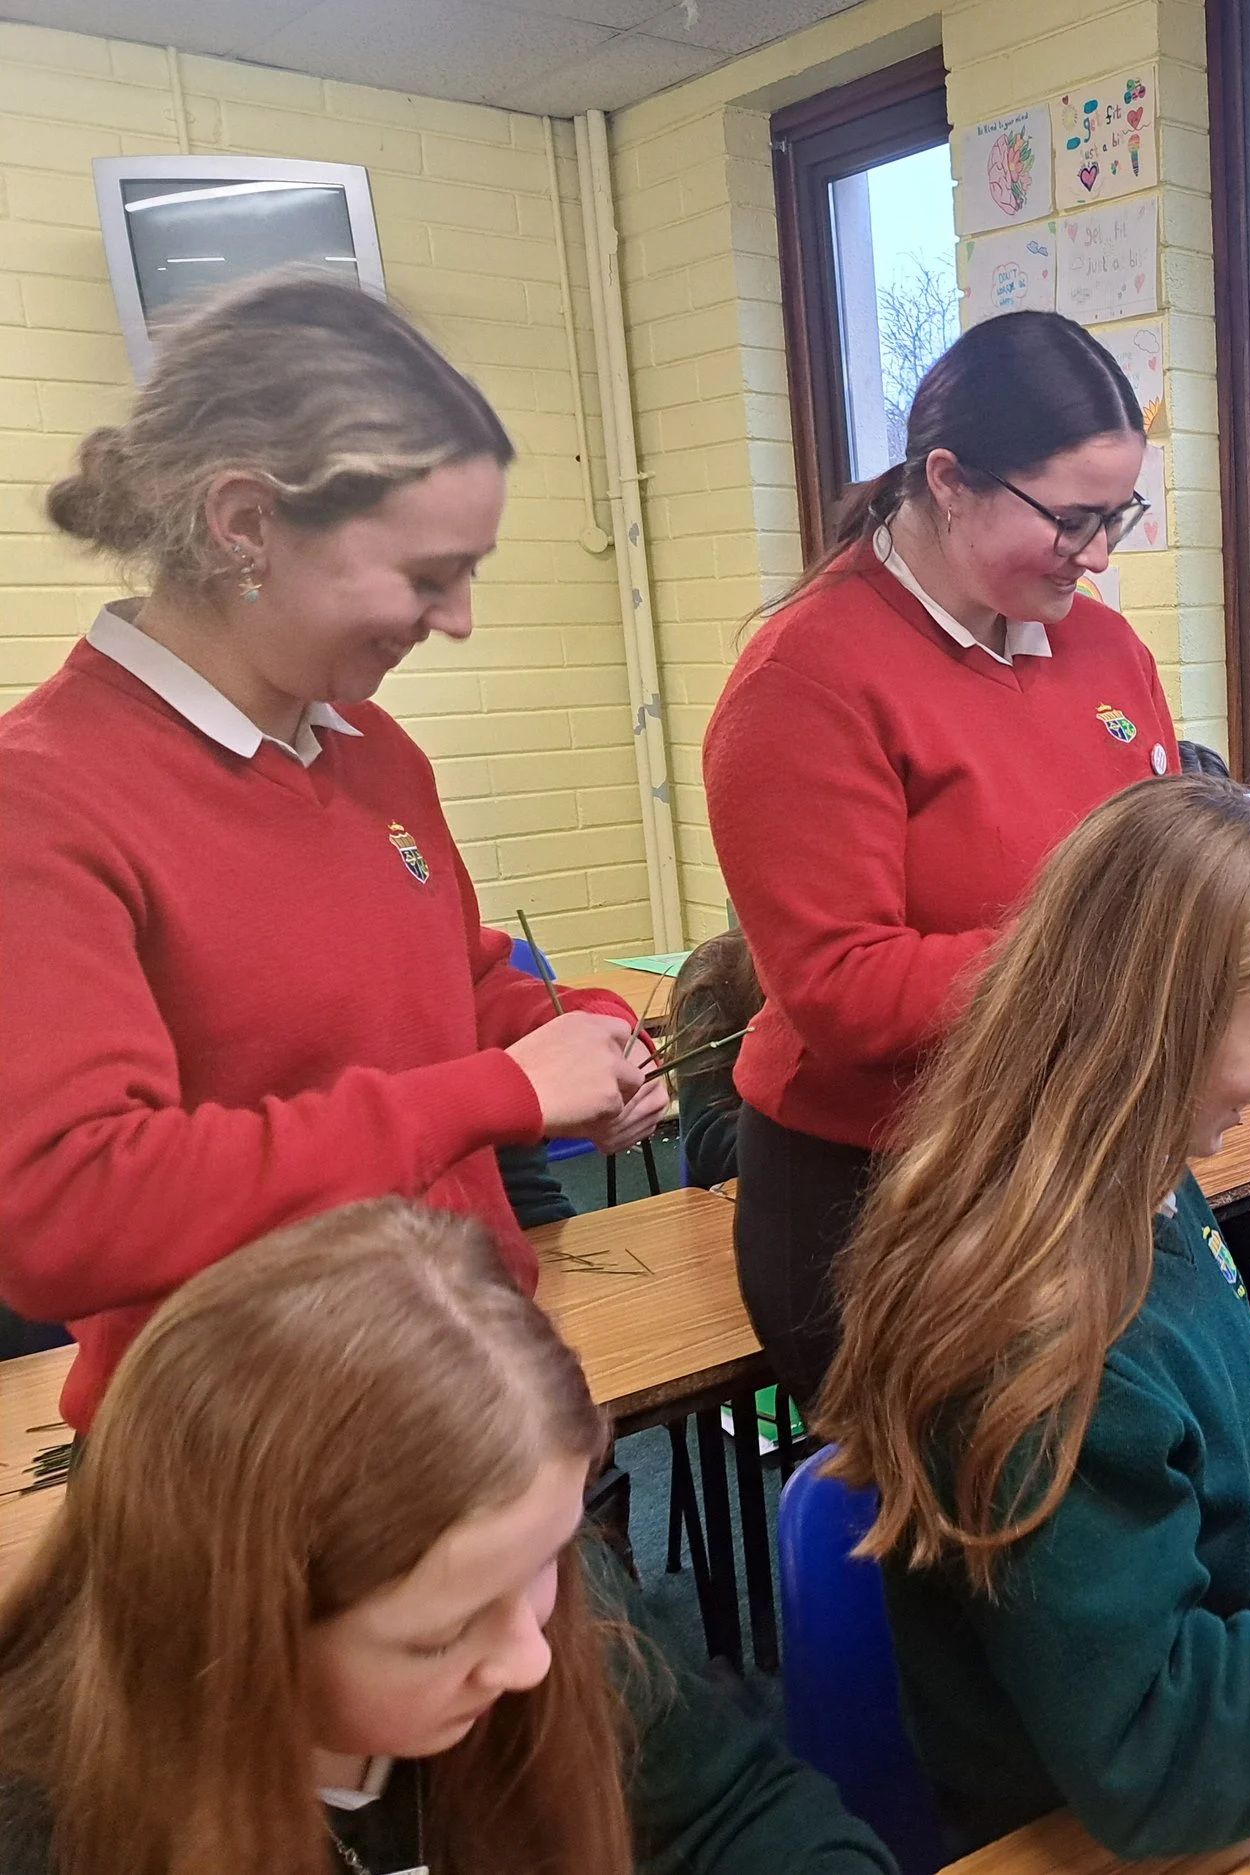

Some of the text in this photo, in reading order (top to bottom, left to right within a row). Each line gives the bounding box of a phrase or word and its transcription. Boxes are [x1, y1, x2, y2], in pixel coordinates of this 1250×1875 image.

[1105, 105, 1122, 125] fit
[1102, 144, 1108, 153] a
[1084, 225, 1103, 246] get
[1086, 256, 1107, 276] just
[1112, 258, 1120, 270] a
